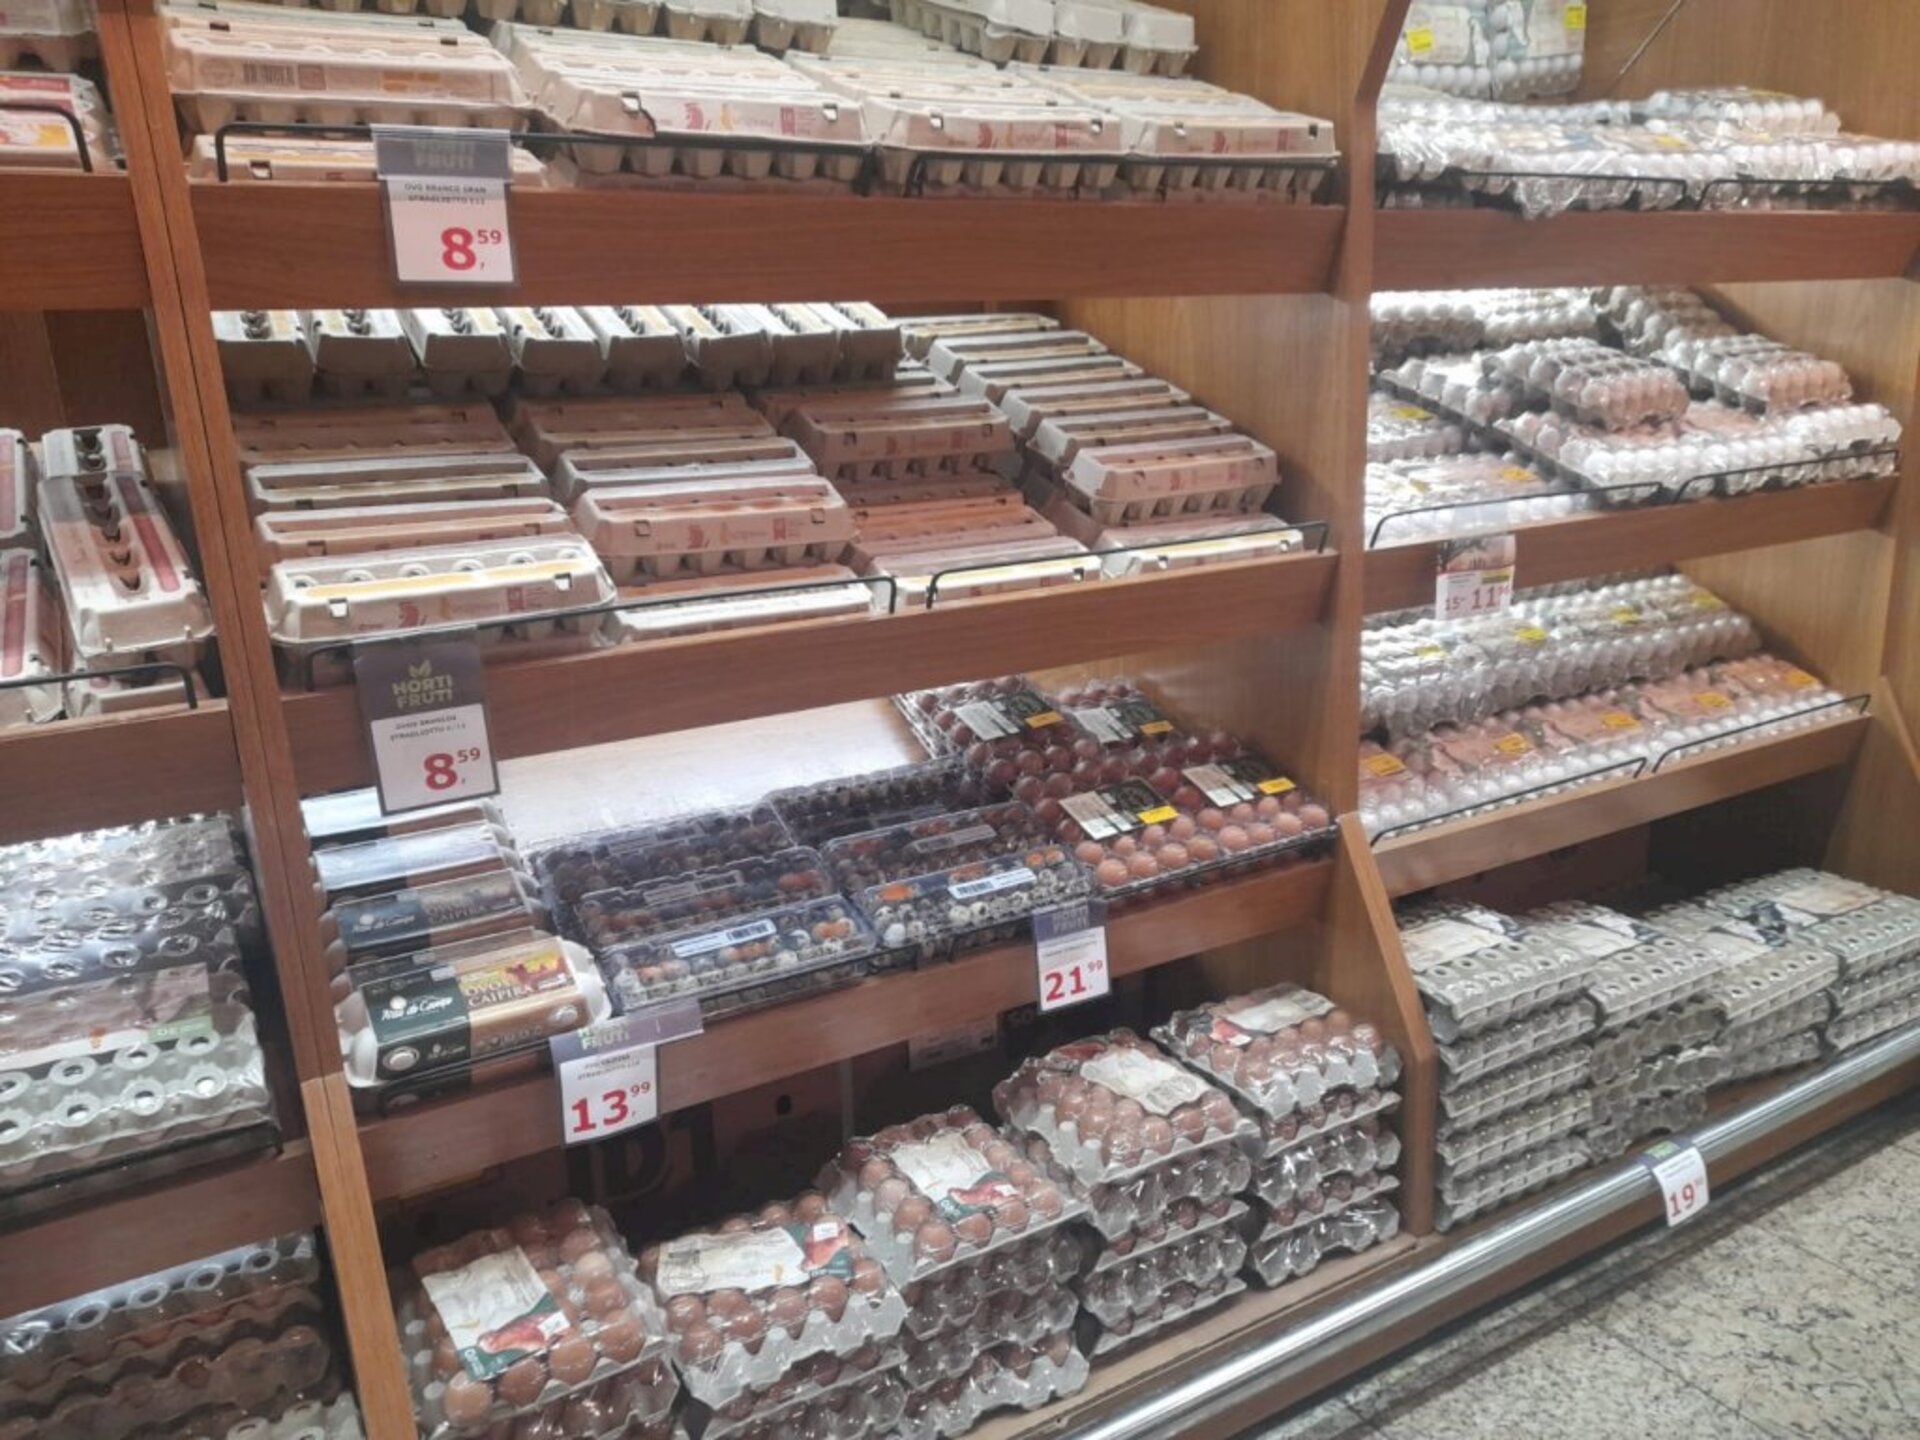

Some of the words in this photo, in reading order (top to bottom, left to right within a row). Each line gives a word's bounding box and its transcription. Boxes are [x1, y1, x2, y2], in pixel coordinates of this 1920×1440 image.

[391, 674, 453, 695] HORTI
[396, 689, 453, 709] FRUTI
[1045, 965, 1086, 1003] 21
[571, 1089, 629, 1134] 13
[630, 1081, 651, 1098] 99
[1669, 1183, 1695, 1218] 19
